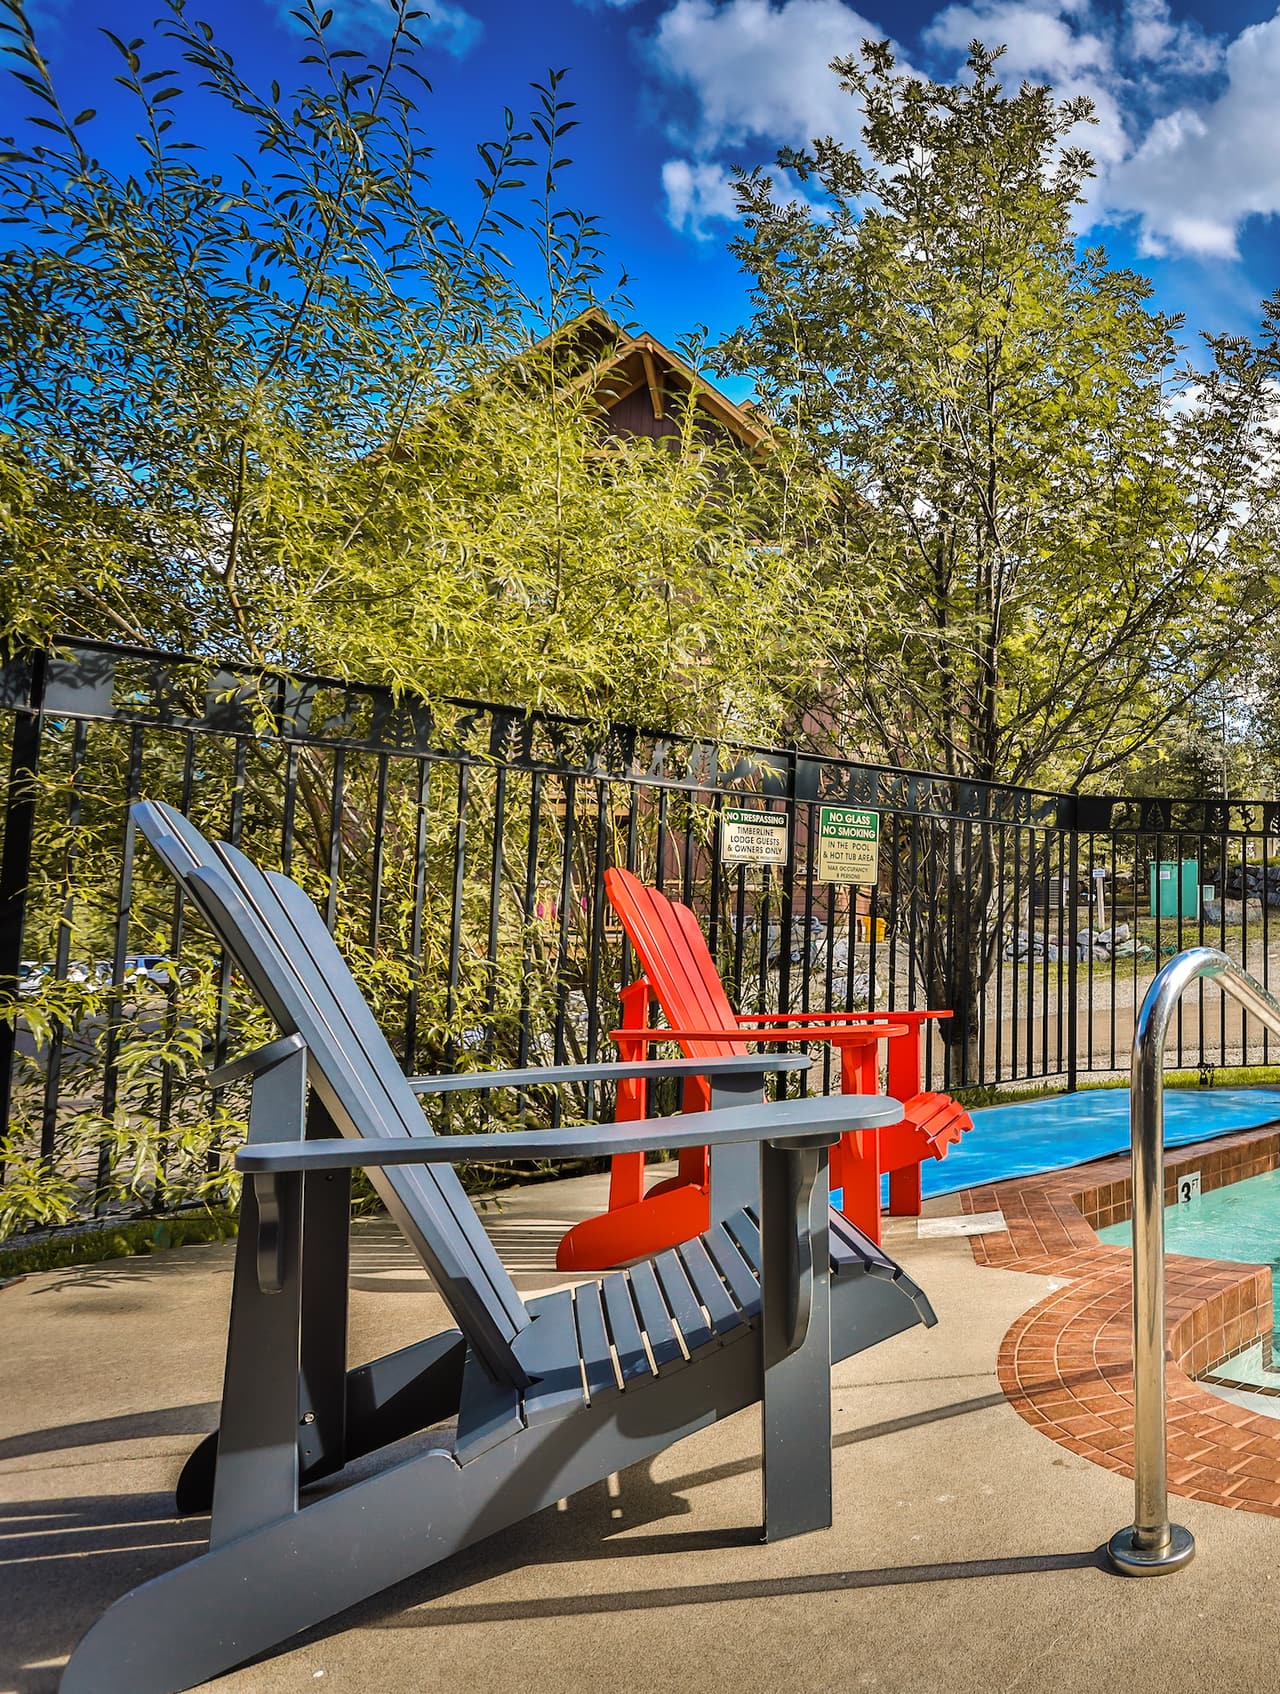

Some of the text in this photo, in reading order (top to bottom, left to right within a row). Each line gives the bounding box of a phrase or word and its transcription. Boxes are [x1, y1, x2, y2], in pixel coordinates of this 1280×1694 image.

[726, 811, 785, 825] NO TRESPASSING
[829, 812, 871, 825] NO GLASS
[737, 826, 774, 837] TIMBERLINE
[822, 825, 876, 839] NO SMOKING
[730, 835, 780, 846] LODGE GUESTS
[727, 844, 783, 855] & OWNERS ONLY
[828, 841, 870, 852] IN THE POOL
[822, 851, 874, 862] & HOT TUB AREA
[1181, 1177, 1200, 1204] 3 FT
